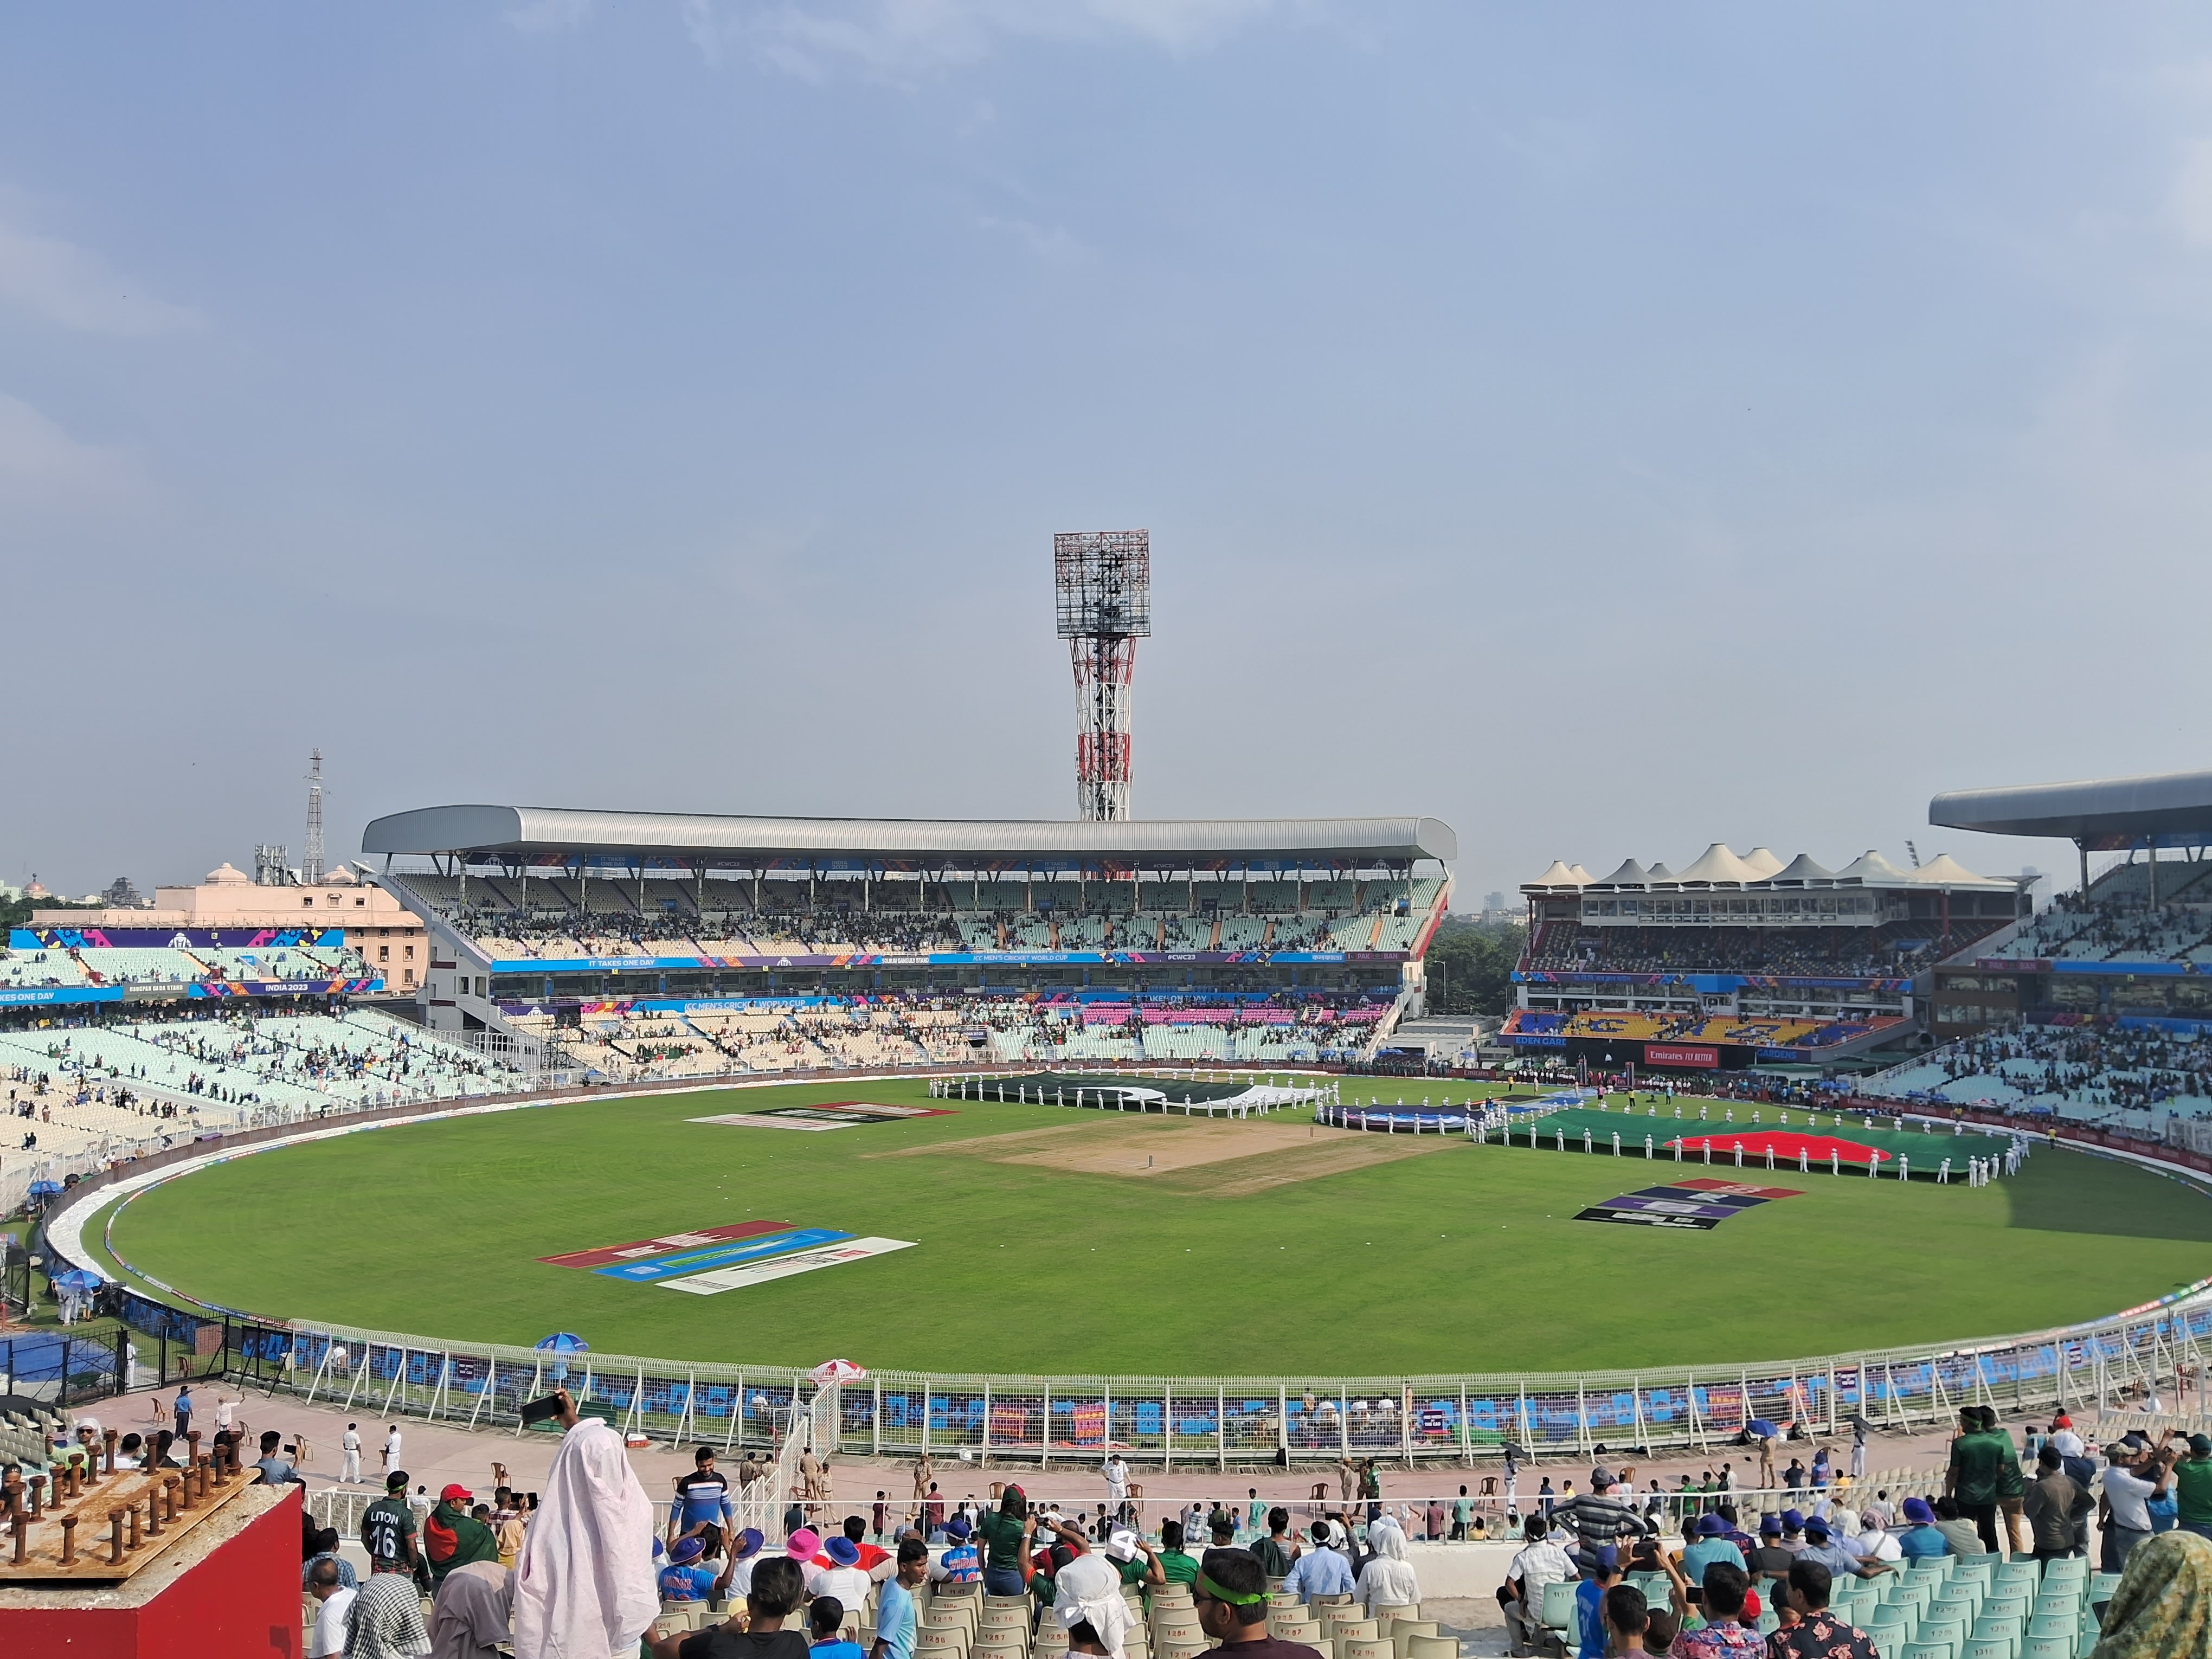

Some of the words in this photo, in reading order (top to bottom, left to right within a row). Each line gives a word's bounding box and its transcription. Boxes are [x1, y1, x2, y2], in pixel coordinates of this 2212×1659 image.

[1650, 1051, 1683, 1060] Emirates
[1685, 1052, 1694, 1061] FLY
[1694, 1053, 1712, 1062] BETTER
[1757, 1049, 1797, 1059] GARDENS
[371, 1511, 398, 1525] LITON
[372, 1526, 396, 1558] 16
[1110, 1530, 1137, 1559] 4
